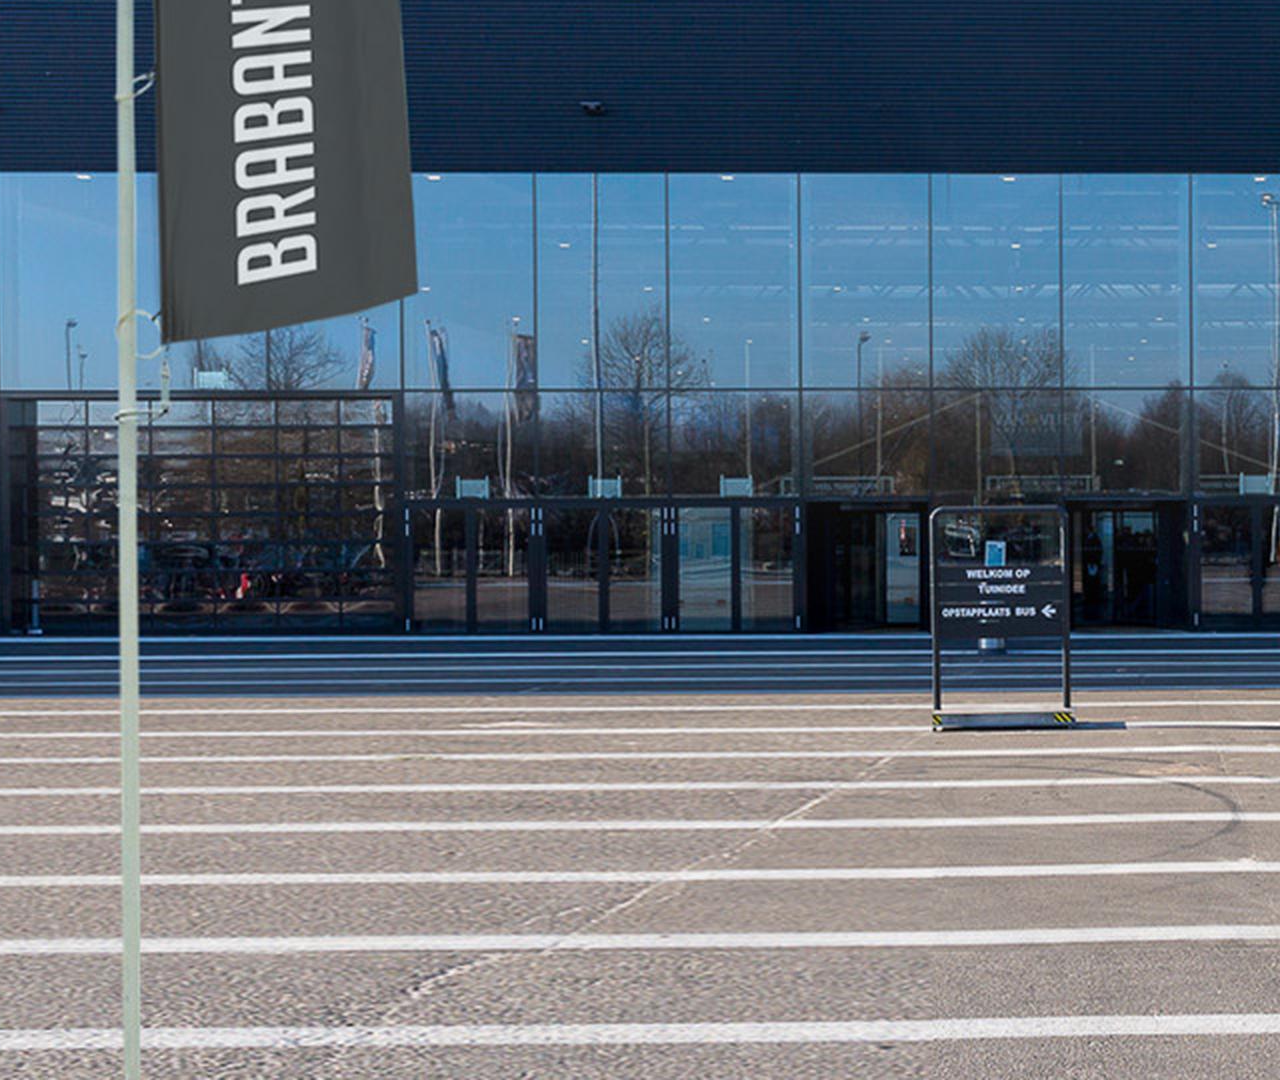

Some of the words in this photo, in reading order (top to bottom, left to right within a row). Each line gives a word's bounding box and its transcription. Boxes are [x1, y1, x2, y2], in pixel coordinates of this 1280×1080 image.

[966, 569, 1013, 578] WELKOM
[1015, 569, 1031, 578] OP
[941, 607, 1011, 618] OPSTAPPLAATS
[1015, 606, 1036, 617] BUS
